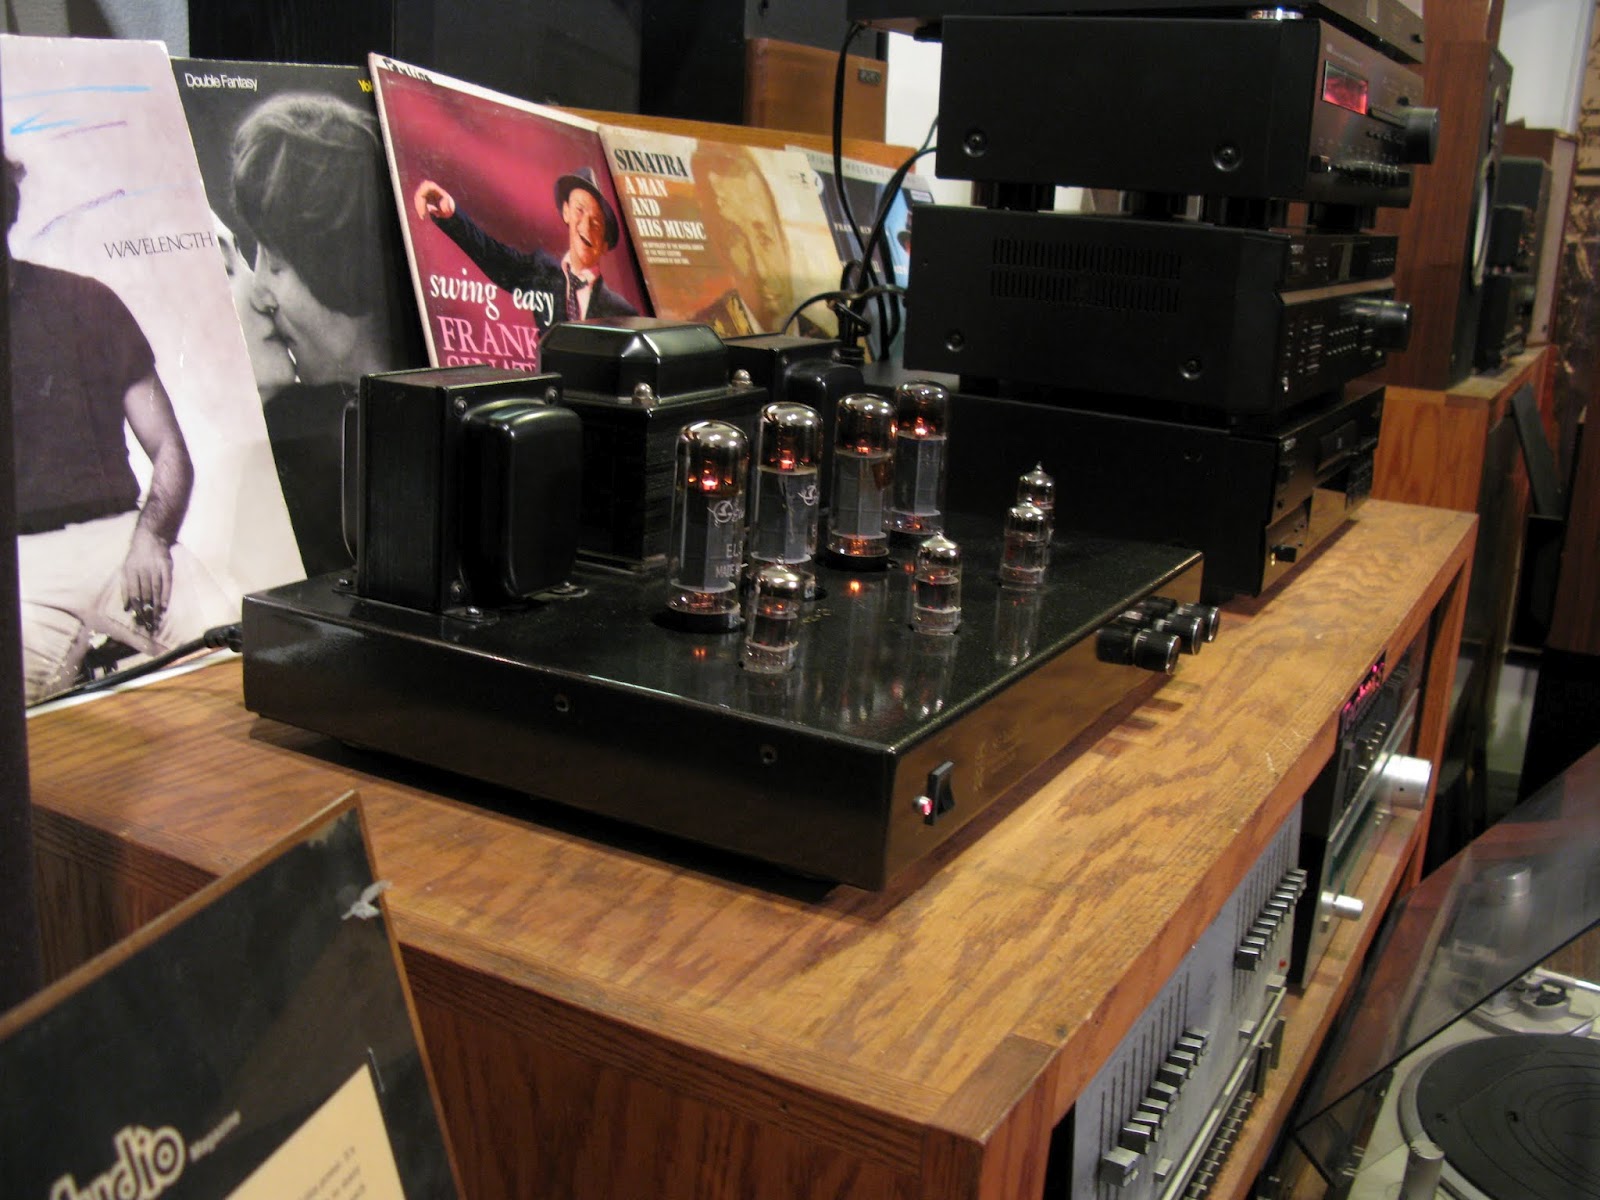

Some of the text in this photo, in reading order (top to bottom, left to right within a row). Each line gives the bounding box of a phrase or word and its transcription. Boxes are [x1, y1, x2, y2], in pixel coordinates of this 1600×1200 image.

[184, 72, 258, 91] Double Fantasy
[613, 148, 689, 177] SINATRA
[624, 176, 669, 198] A MAN
[631, 197, 660, 217] AND
[635, 218, 707, 240] HIS MUSIC
[103, 230, 214, 259] WAVELENGTH
[429, 267, 555, 327] swing easy
[436, 315, 541, 360] FRANK
